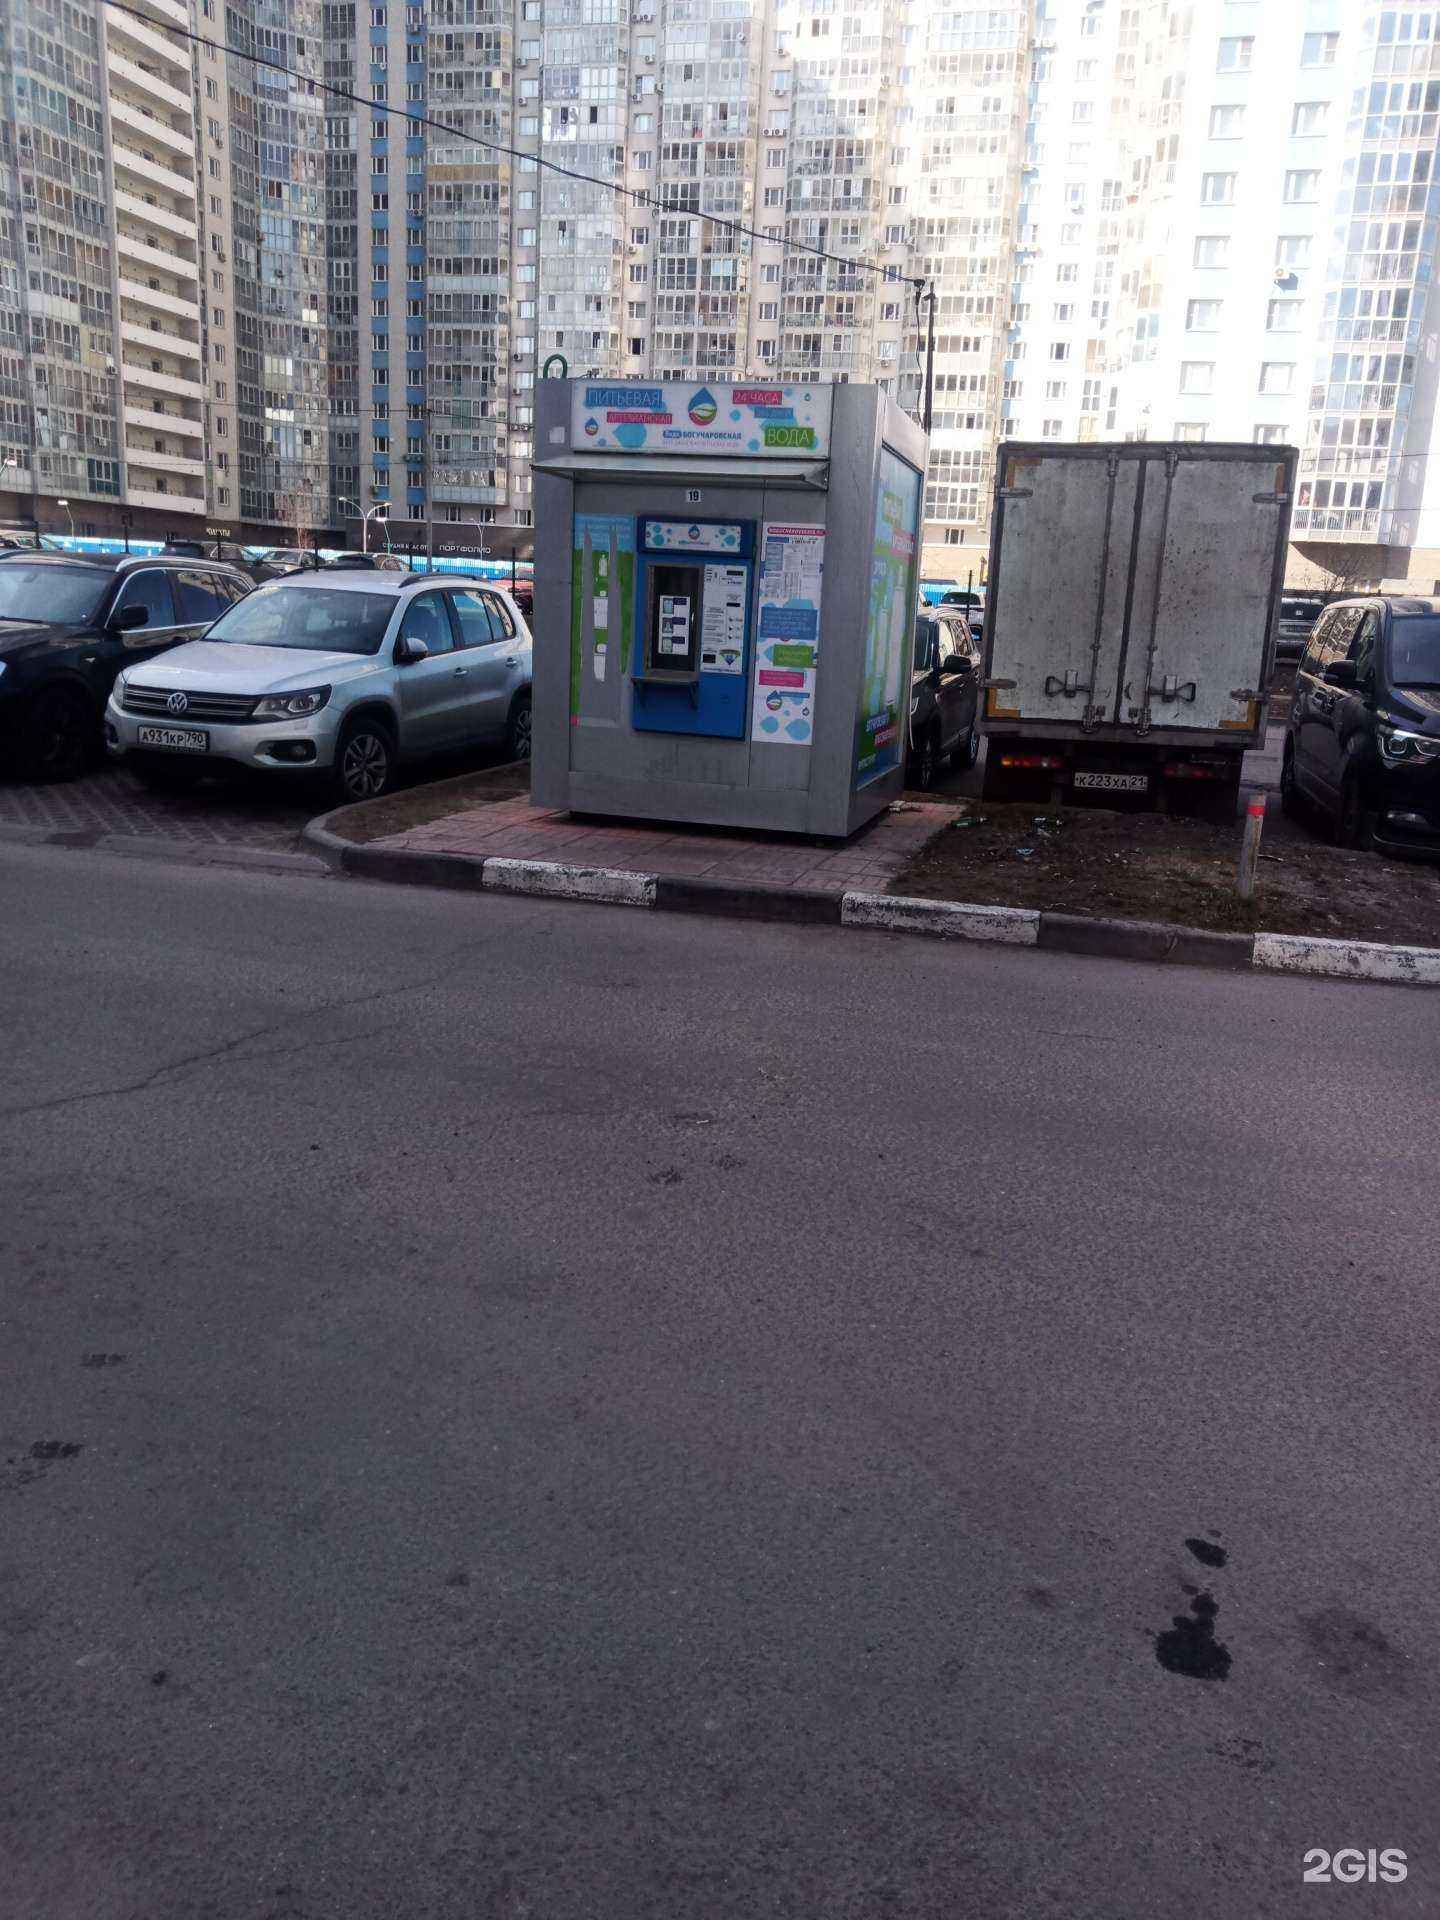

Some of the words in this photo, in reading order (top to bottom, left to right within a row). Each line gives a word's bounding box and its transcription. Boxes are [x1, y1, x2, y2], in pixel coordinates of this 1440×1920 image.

[588, 390, 661, 407] ПИТЬЕВАЯ
[735, 391, 748, 403] 24
[750, 392, 780, 405] ЧАСА
[682, 431, 742, 440] БОГУЧАРОВСКАЯ
[768, 428, 809, 446] ВОДА
[688, 490, 700, 502] 19
[439, 545, 492, 554] ПОРТФОЛИО
